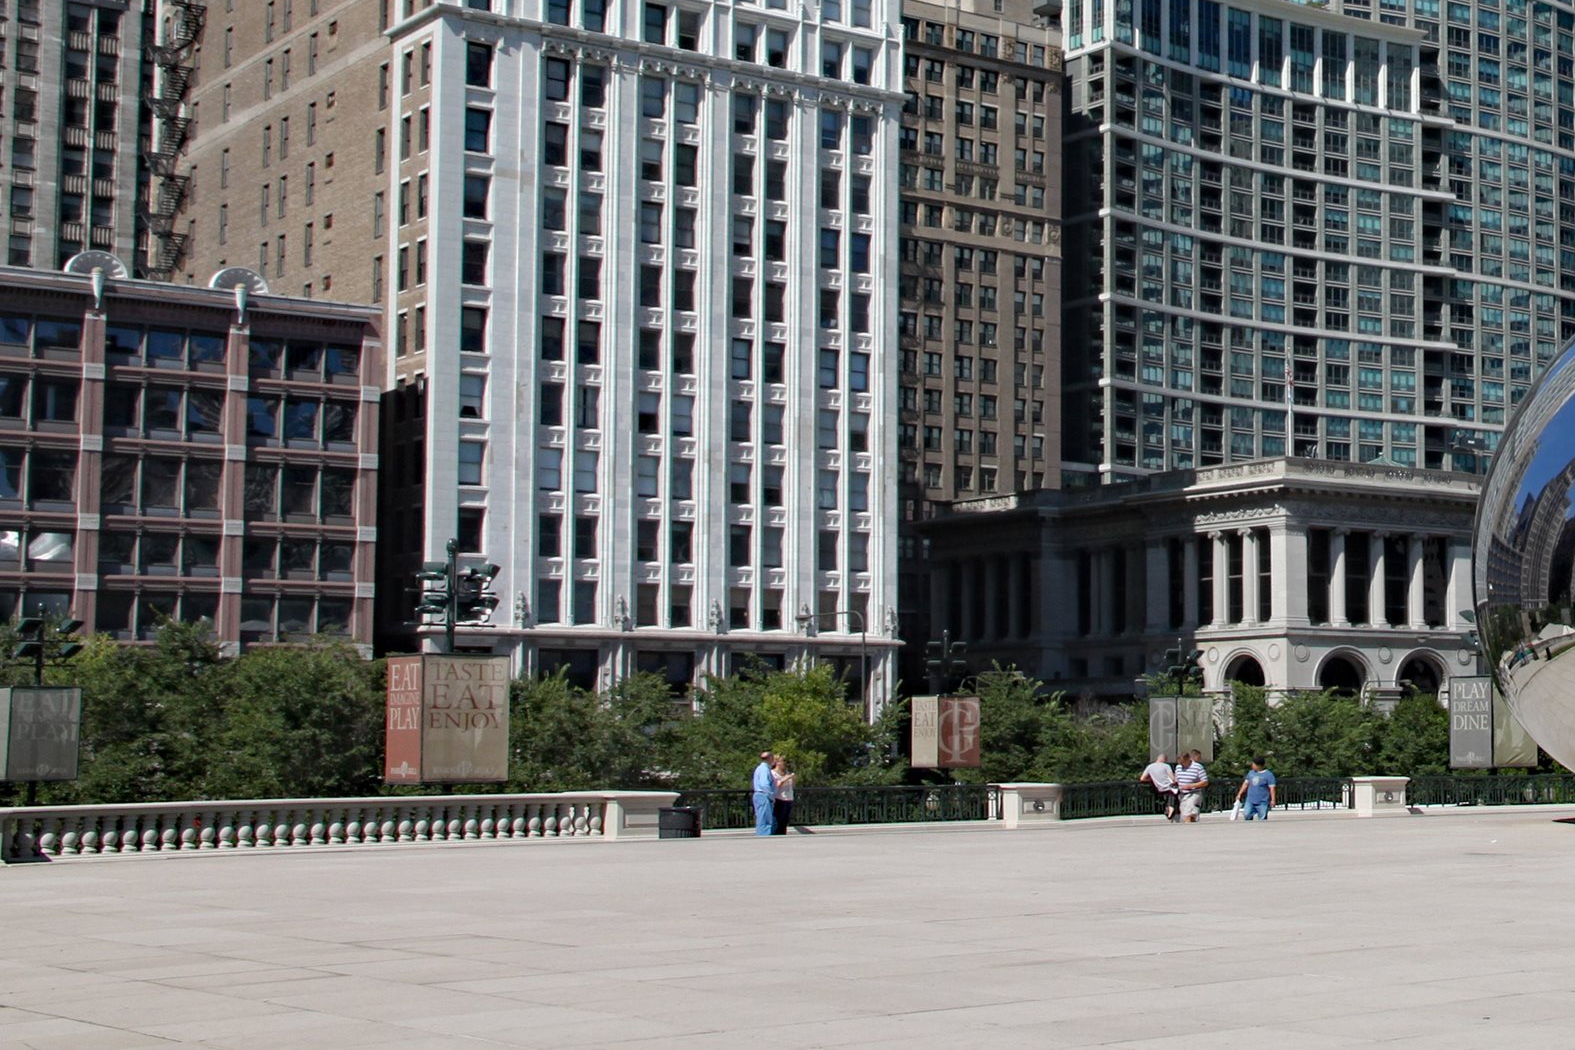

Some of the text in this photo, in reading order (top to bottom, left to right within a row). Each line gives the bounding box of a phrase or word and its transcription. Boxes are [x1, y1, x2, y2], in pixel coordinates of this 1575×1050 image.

[391, 662, 420, 691] EAT
[430, 662, 505, 681] TASTE
[430, 683, 504, 710] EAT
[1453, 682, 1488, 699] PLAY
[1453, 701, 1489, 712] DREAM
[389, 707, 420, 730] PLAY
[429, 711, 504, 733] ENJOY
[914, 711, 936, 727] EAT
[1453, 714, 1489, 730] DINE
